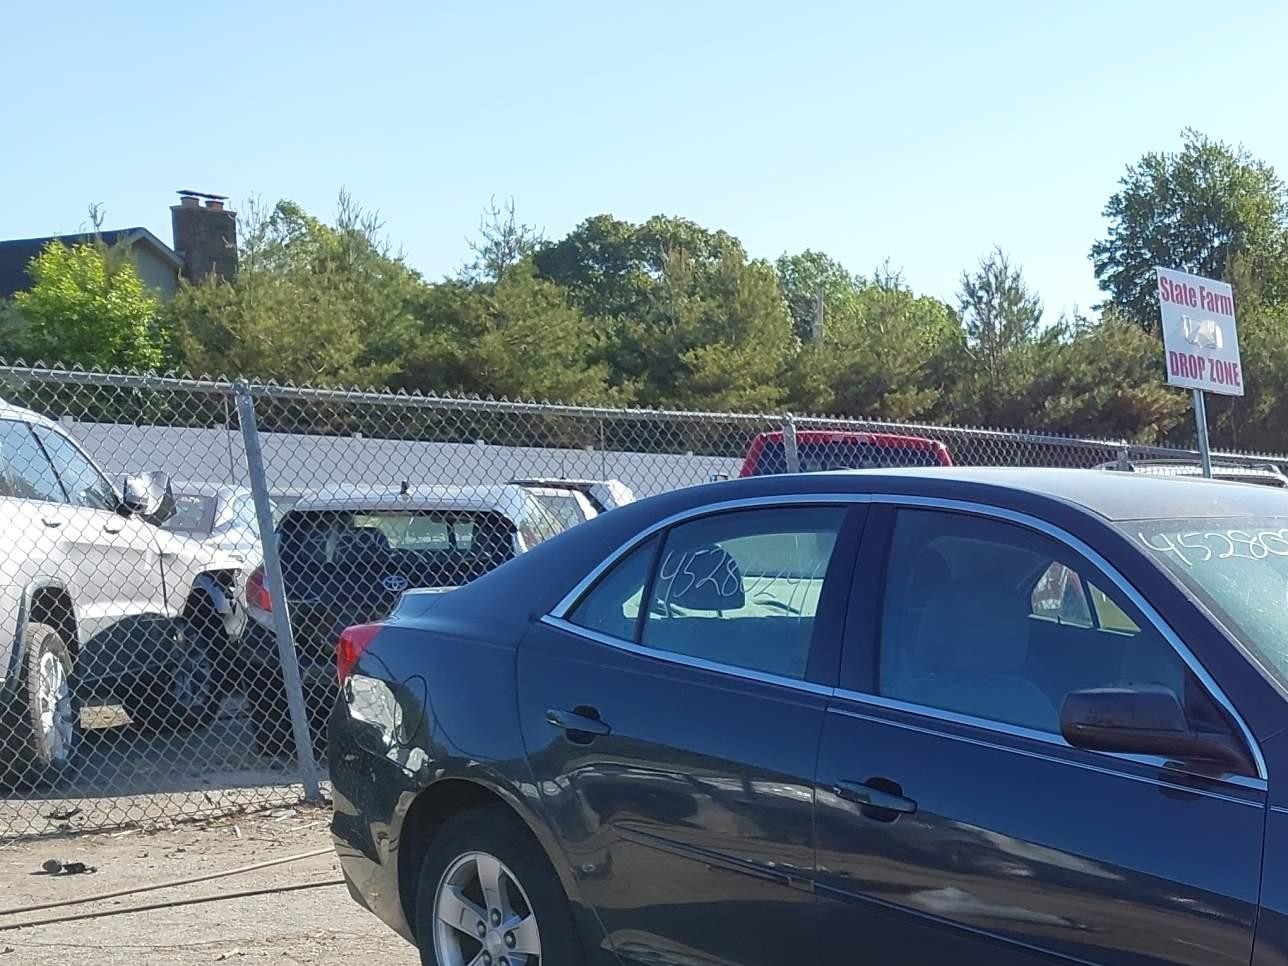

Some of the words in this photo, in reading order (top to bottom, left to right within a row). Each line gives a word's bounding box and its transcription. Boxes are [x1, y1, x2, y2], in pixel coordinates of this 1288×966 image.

[1160, 276, 1197, 308] State
[1199, 285, 1233, 317] Farm
[1168, 350, 1206, 381] DROP
[1208, 358, 1241, 387] ZONE
